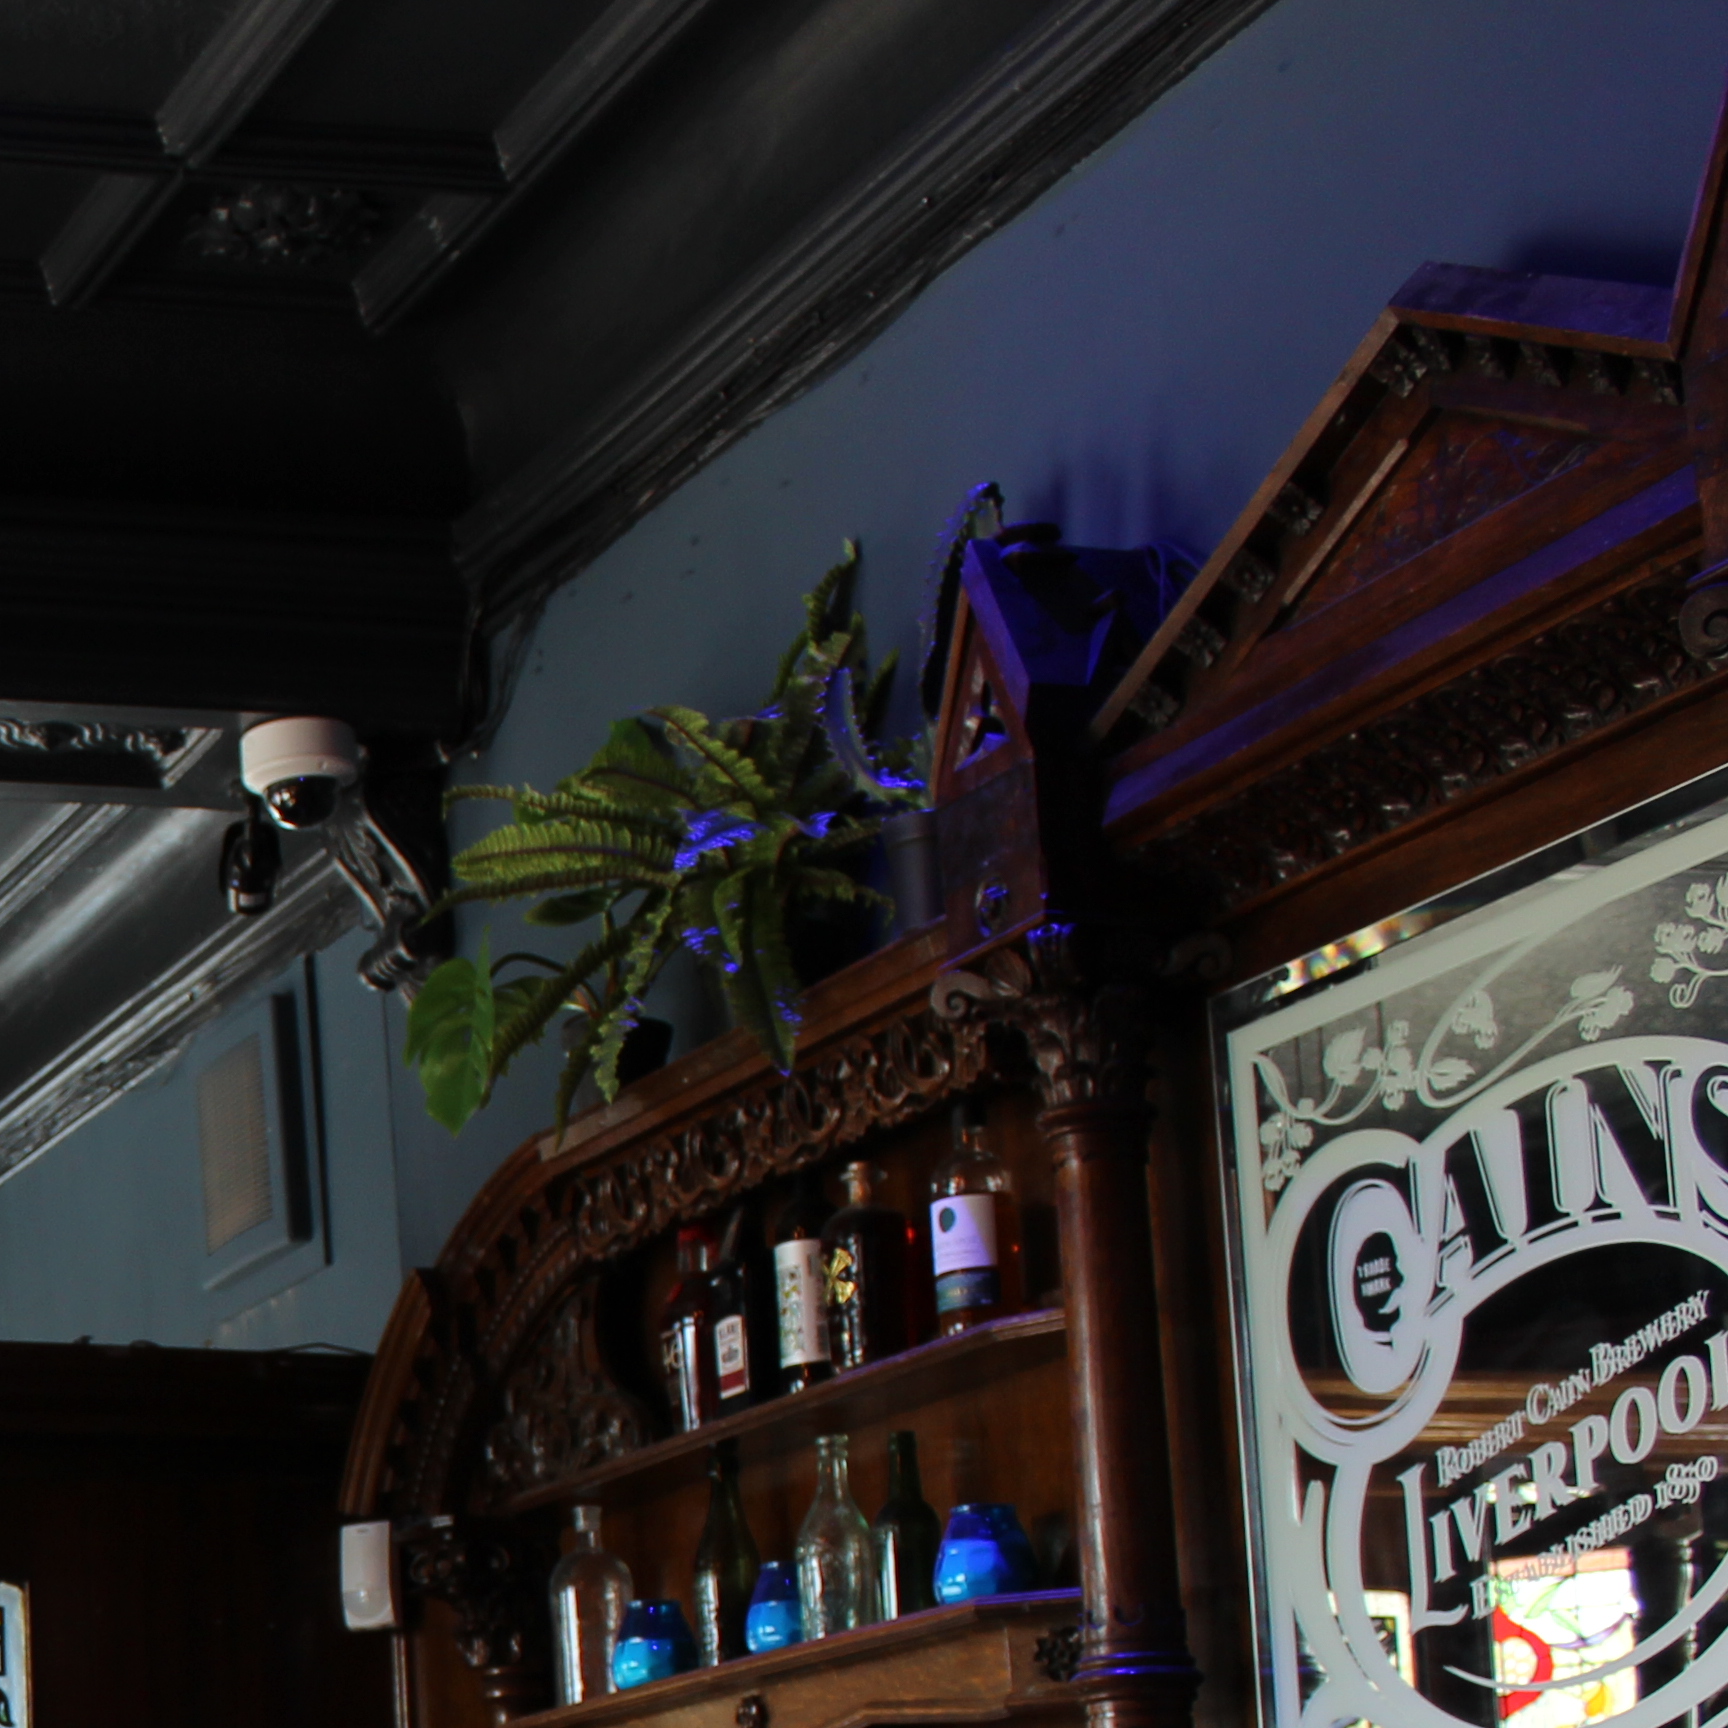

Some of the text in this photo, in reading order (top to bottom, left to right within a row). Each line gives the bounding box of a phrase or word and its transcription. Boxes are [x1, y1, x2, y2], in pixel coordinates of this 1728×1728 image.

[1436, 1290, 1709, 1487] ROBERT CAIN BREWERY
